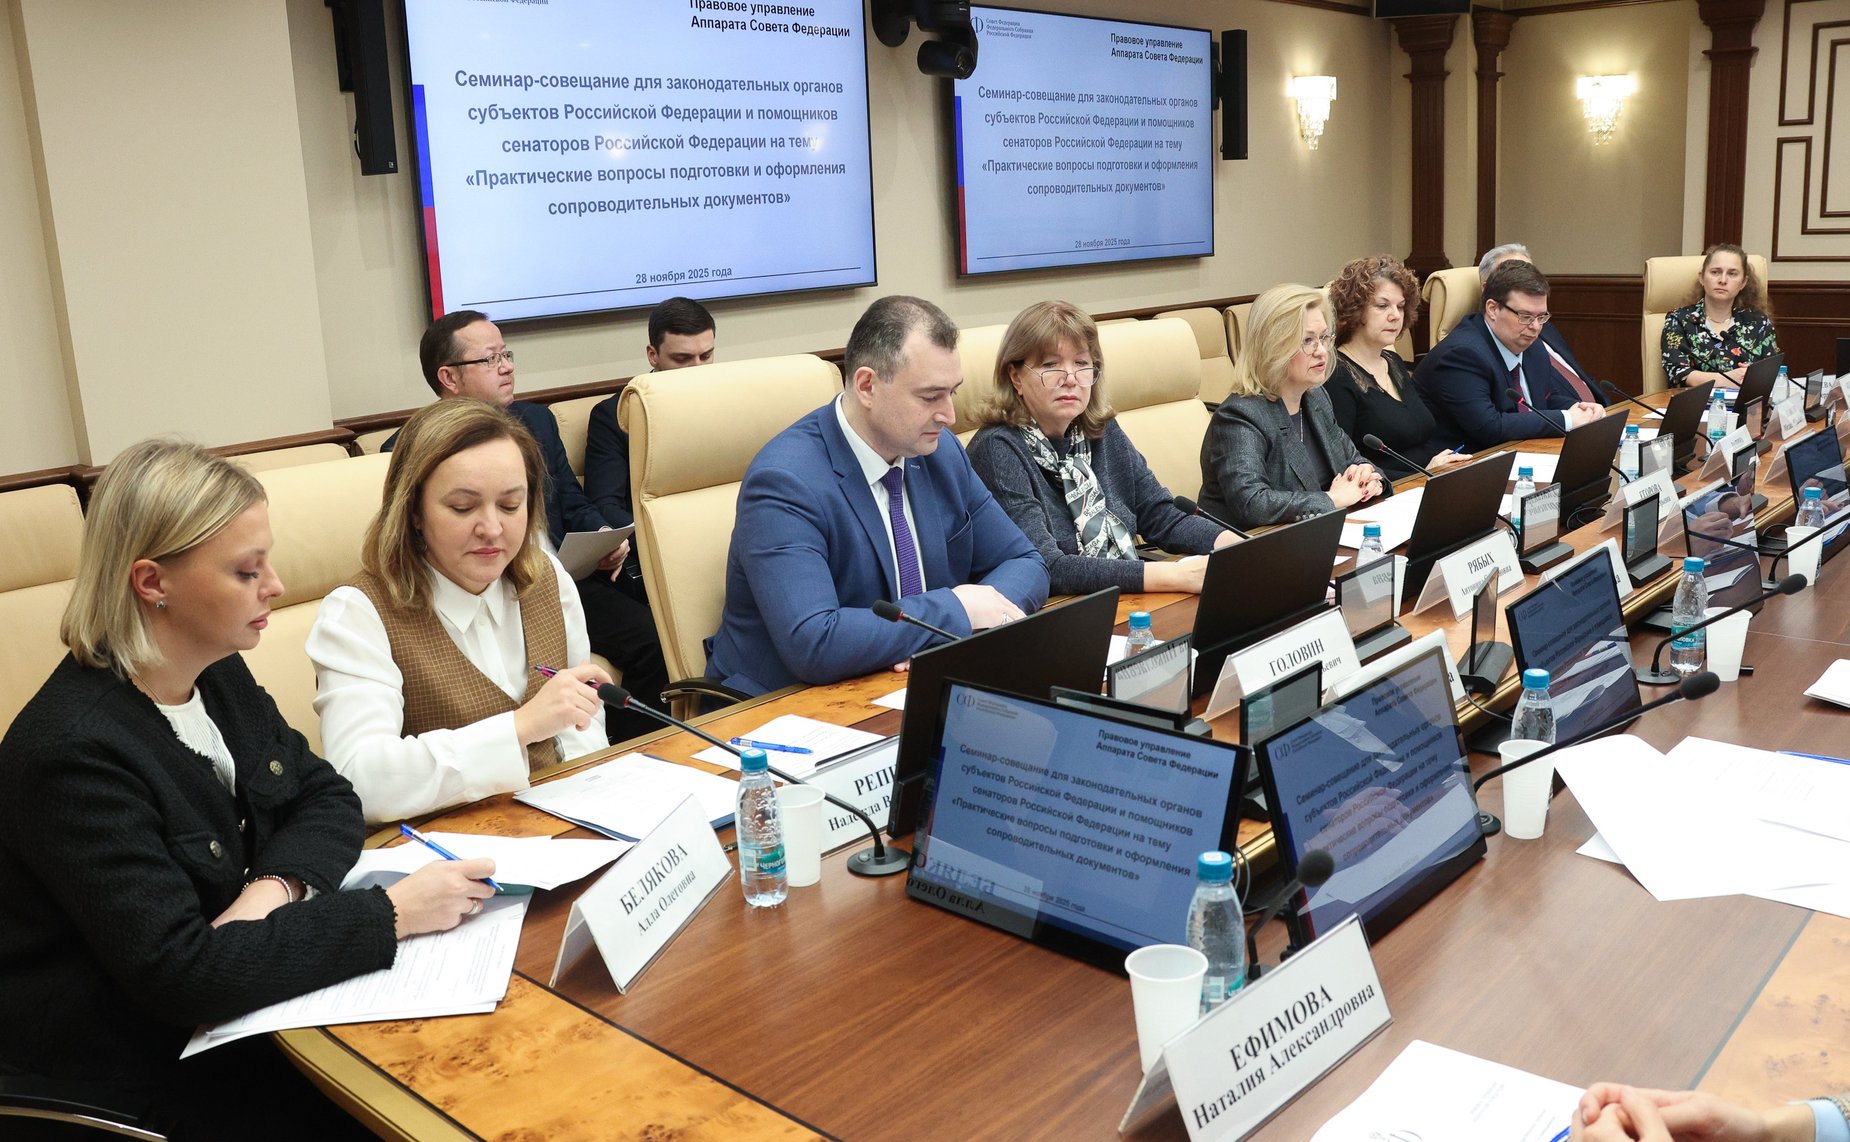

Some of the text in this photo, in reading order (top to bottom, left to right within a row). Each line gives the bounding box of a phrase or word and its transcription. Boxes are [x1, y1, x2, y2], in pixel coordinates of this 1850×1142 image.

[689, 0, 815, 17] Правовое управление
[690, 15, 850, 38] Аппарата Совета Федерации
[1110, 32, 1183, 49] Правовое управление
[1110, 47, 1203, 65] Аппарата Совета Федерации
[454, 69, 843, 96] Семинар-совещание для законодательных органов
[977, 85, 1198, 108] Семинар-совещание для законодательных органов
[467, 103, 838, 124] субъектов Российской Федерации и помощников
[984, 112, 1194, 129] субъектов Российской Федерации и помощников
[501, 133, 818, 155] сенаторов Российской Федерации на тему
[1002, 136, 1182, 151] сенаторов Российской Федерации на тему
[465, 161, 846, 190] «Практические вопросы подготовки и оформления
[981, 159, 1198, 174] «Практические вопросы подготовки и оформления
[1026, 181, 1166, 196] сопроводительных документов»
[548, 192, 791, 217] сопроводительных документов»
[635, 267, 733, 284] 28 ноября 2025 года
[1467, 552, 1495, 574] РЯБЫХ
[1269, 638, 1325, 677] ГОЛОВИН
[619, 842, 689, 916] БЕЛЯКОВА
[637, 869, 696, 936] Алла Олеговна
[1229, 984, 1333, 1072] ЕФИМОВА
[1192, 984, 1375, 1130] Наталия Александровна
